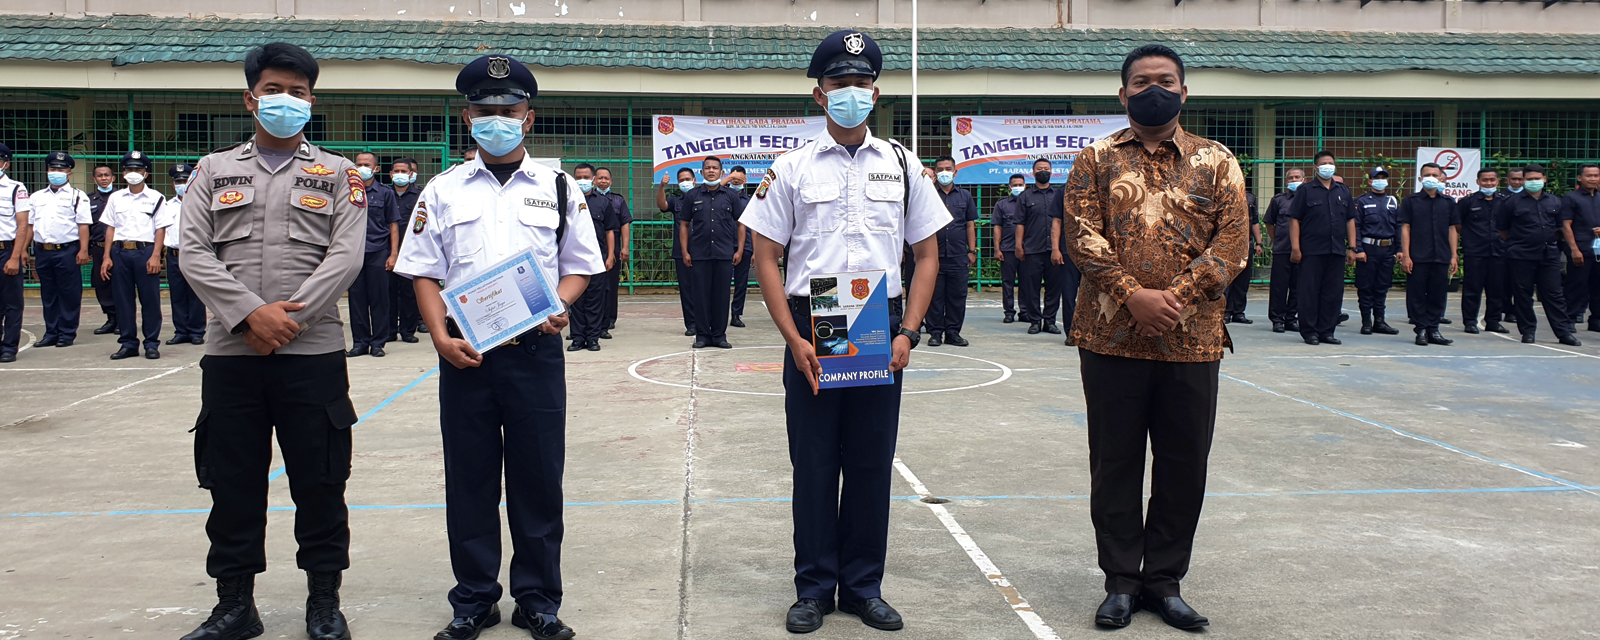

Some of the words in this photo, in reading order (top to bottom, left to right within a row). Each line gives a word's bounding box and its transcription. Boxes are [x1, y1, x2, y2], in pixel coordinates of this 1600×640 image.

[662, 135, 753, 160] TANGGUH
[759, 135, 814, 150] SECU
[960, 135, 1049, 160] TANGGUH
[1026, 153, 1063, 161] ANGKATAN
[213, 176, 254, 190] EDWIN
[294, 176, 336, 193] POLRI
[1443, 189, 1472, 197] RANG
[526, 199, 557, 209] SATPAM
[818, 370, 858, 383] COMPANY
[860, 369, 889, 380] PROFILE
